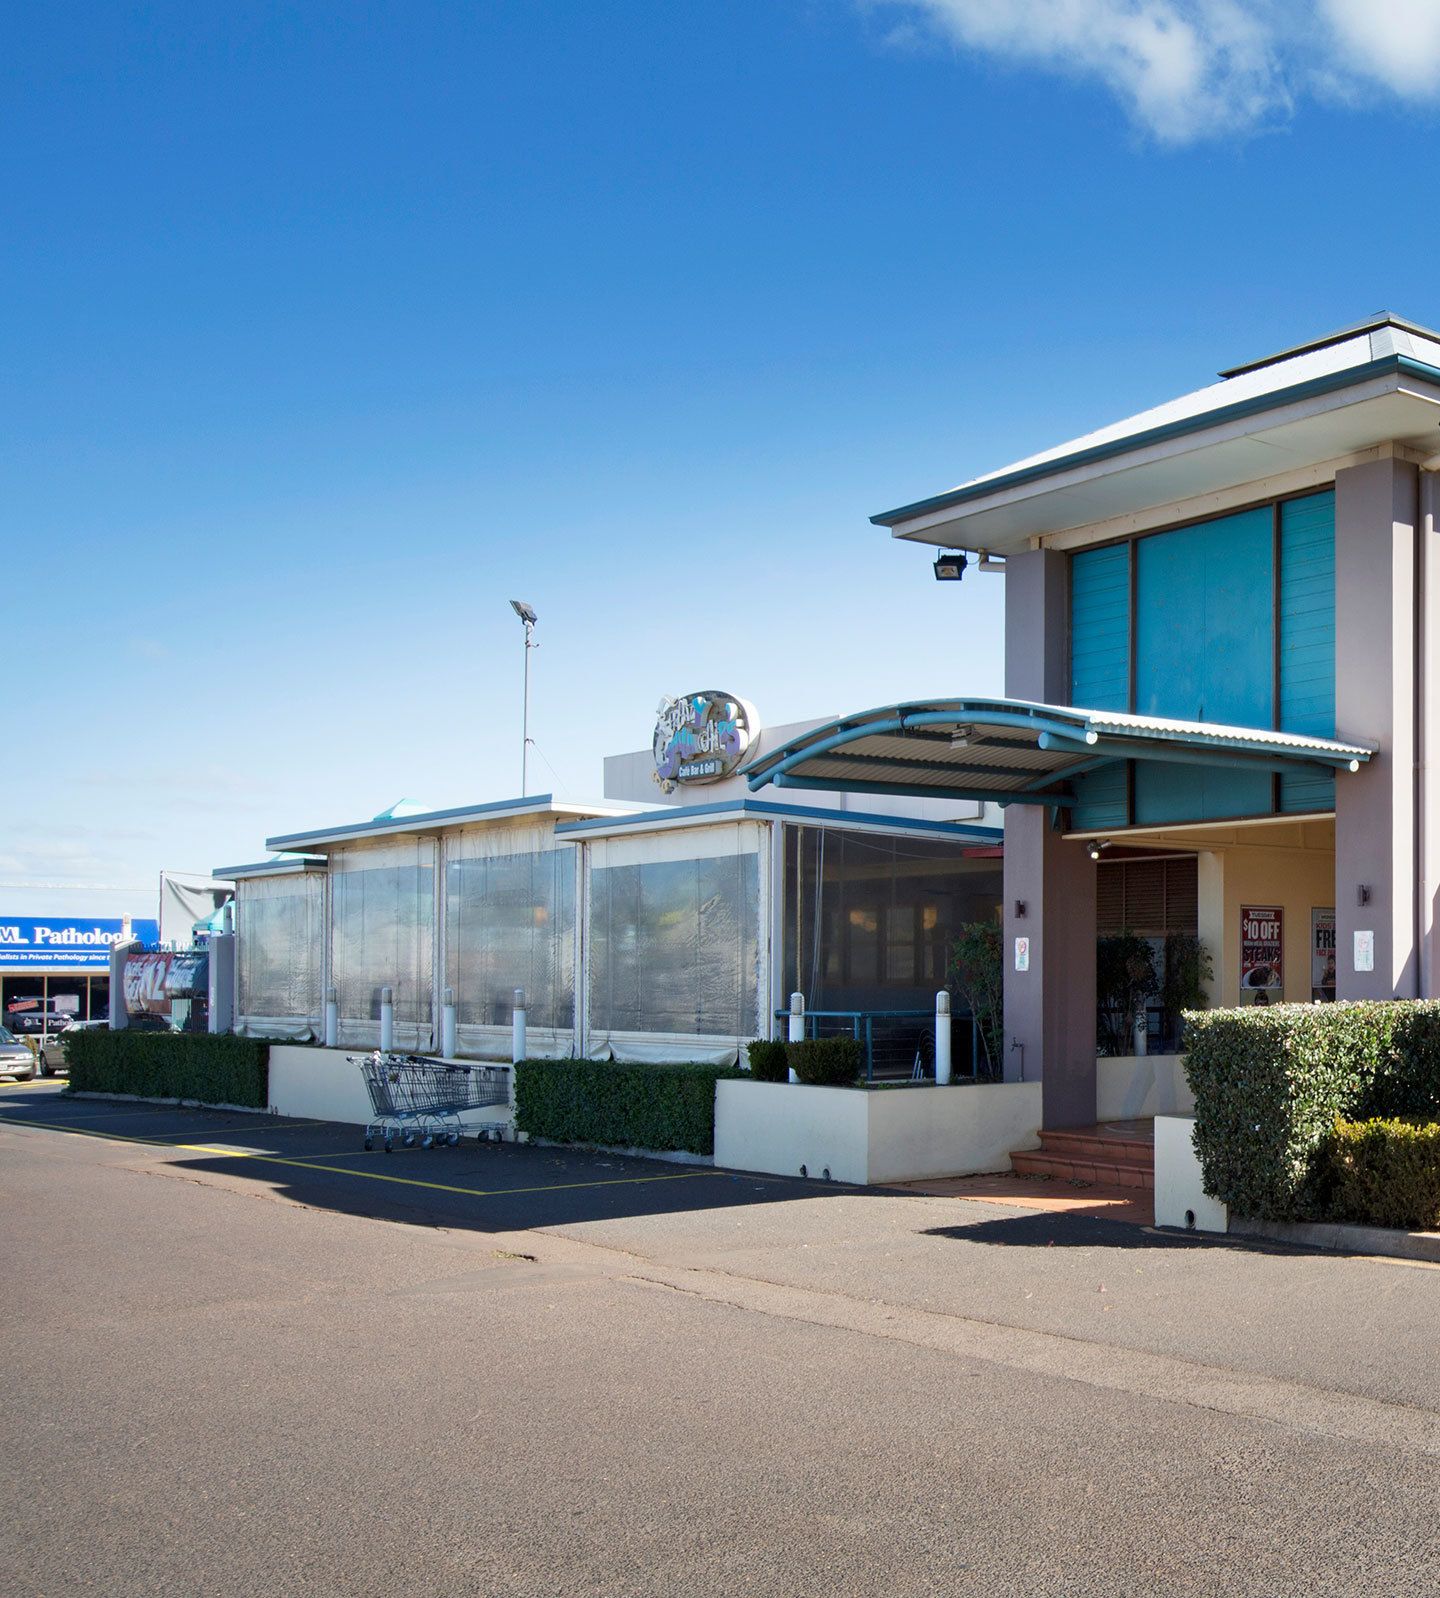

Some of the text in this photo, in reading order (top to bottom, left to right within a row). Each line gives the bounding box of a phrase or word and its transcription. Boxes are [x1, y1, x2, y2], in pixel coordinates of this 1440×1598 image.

[691, 765, 699, 775] Bar
[700, 764, 704, 774] &
[705, 762, 715, 773] Grill
[1243, 919, 1280, 940] $10 OFF
[1316, 929, 1336, 948] FRE
[54, 954, 88, 962] Pathology
[1243, 946, 1280, 962] STEAKS
